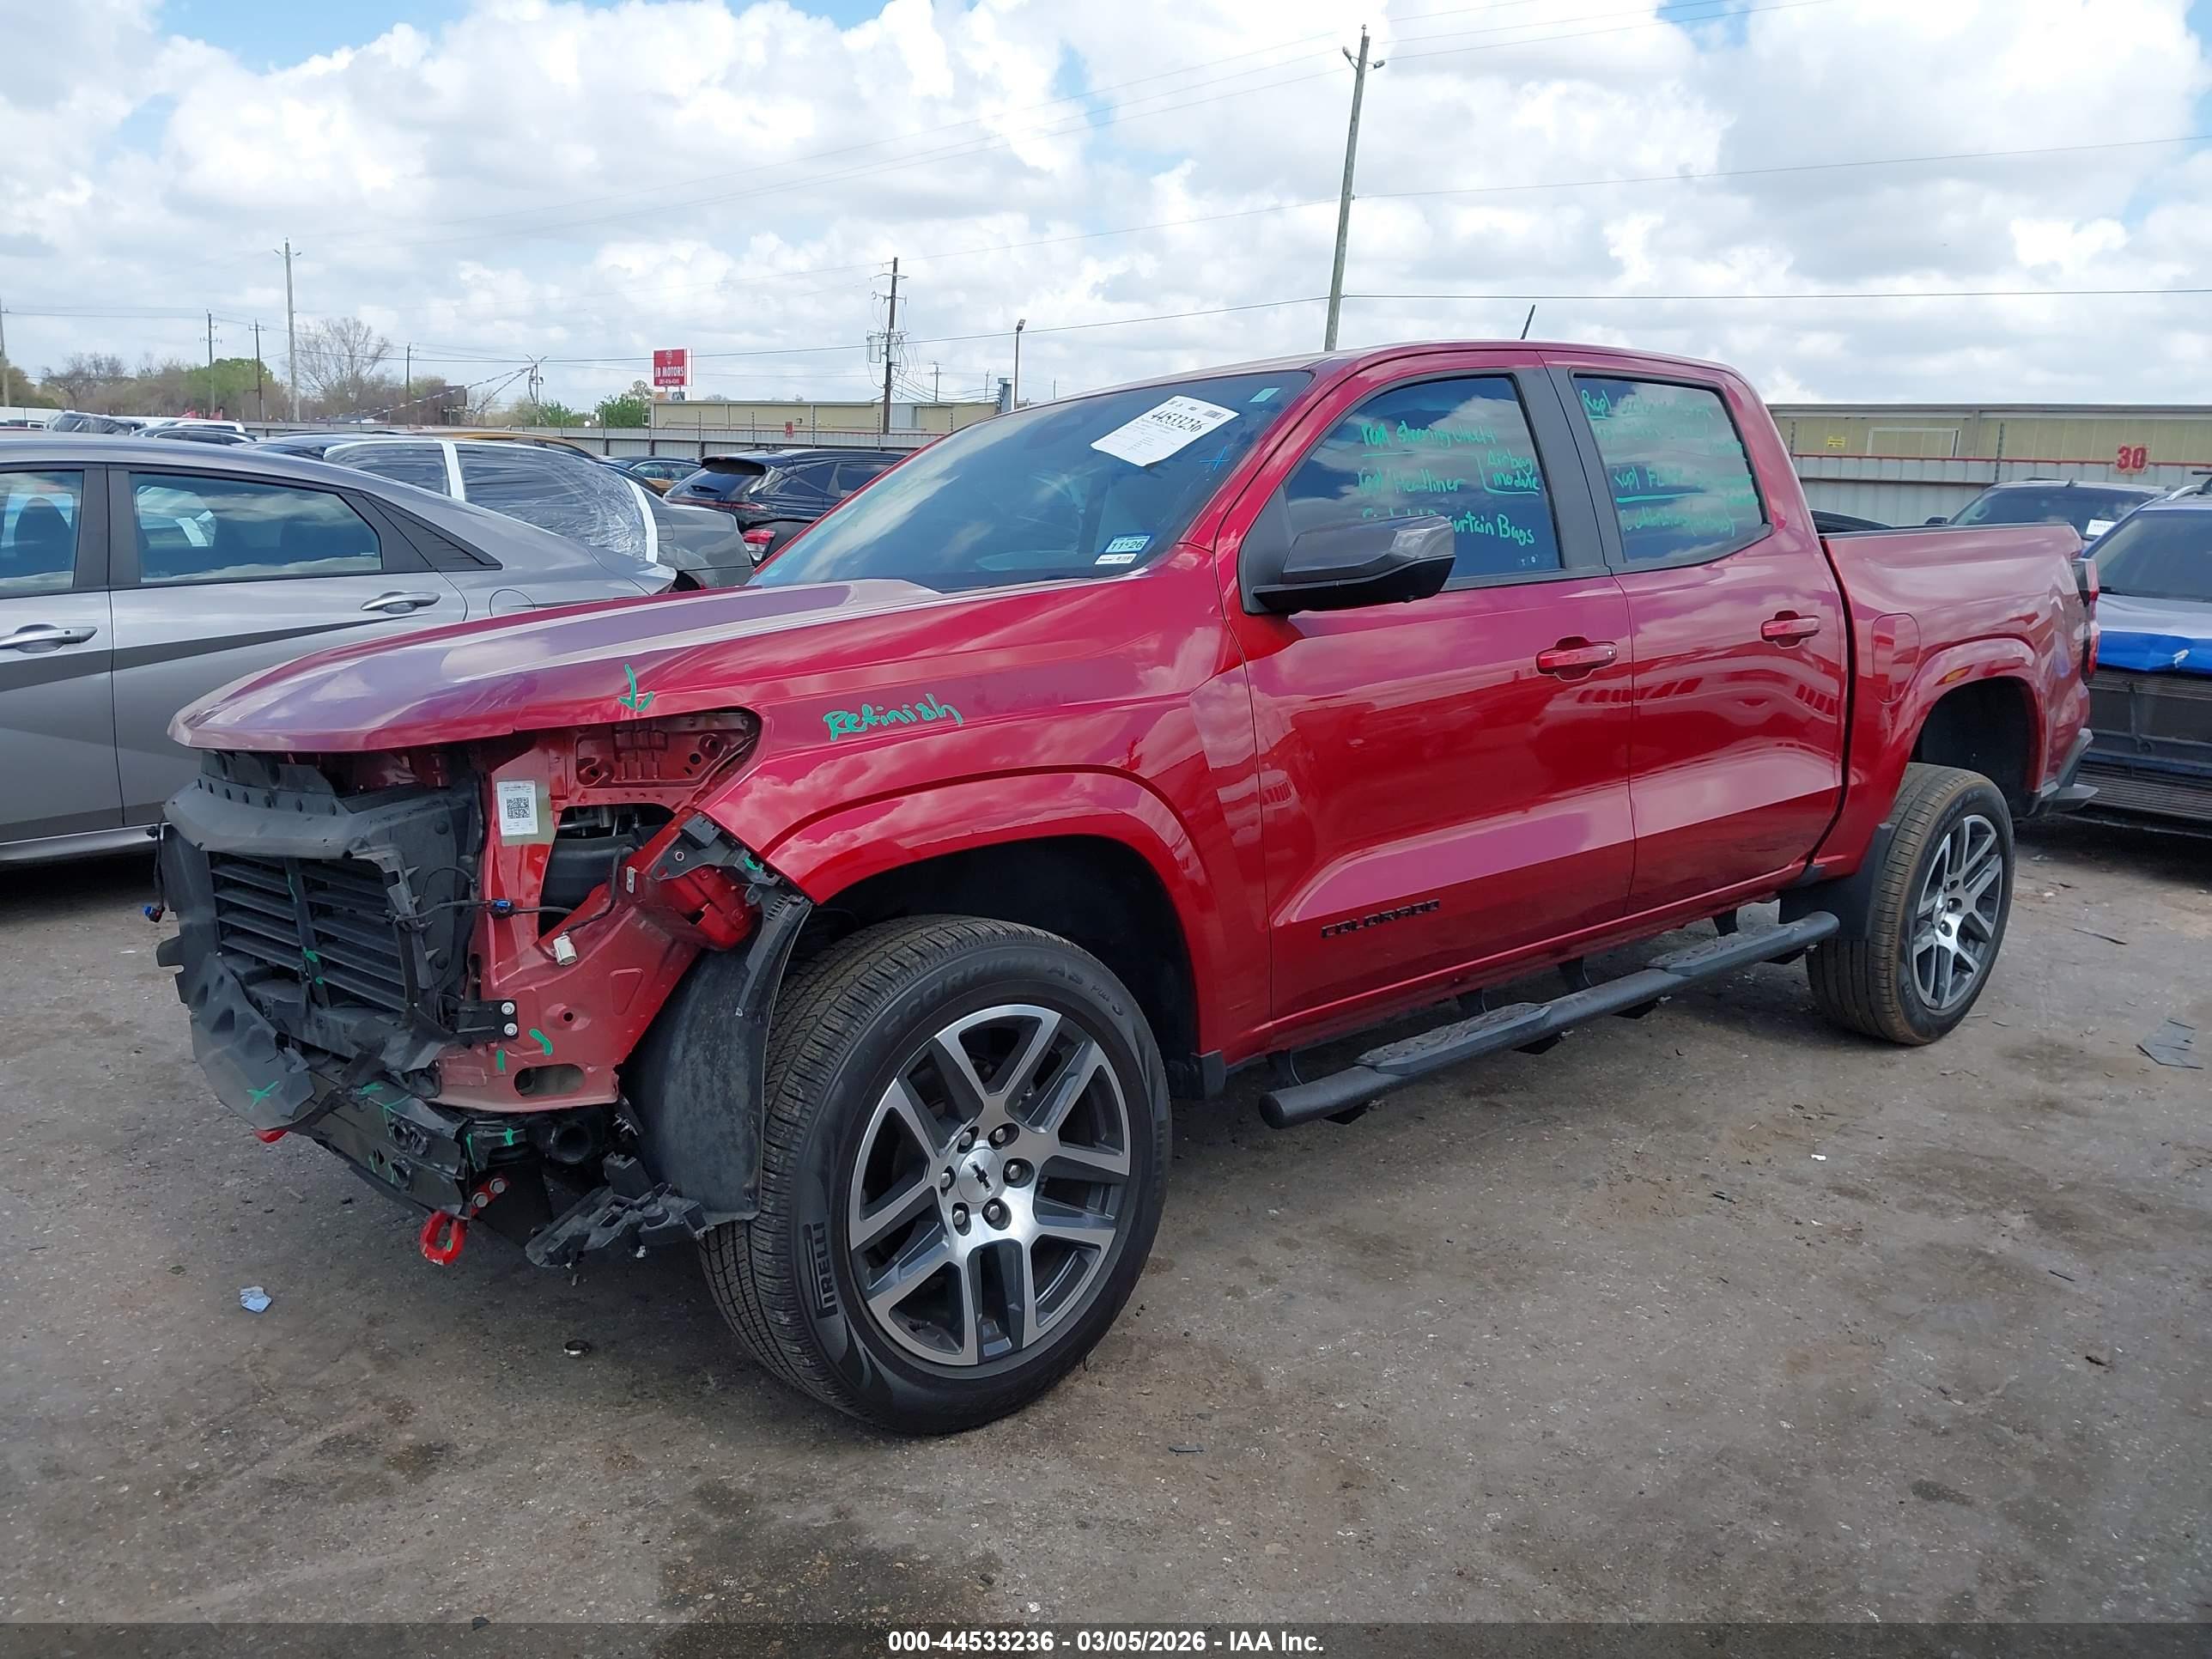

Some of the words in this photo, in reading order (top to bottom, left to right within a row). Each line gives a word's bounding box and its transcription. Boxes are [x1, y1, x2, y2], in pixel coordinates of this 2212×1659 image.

[662, 365, 684, 378] MOTORS
[1151, 410, 1208, 433] 44533236
[2118, 446, 2147, 469] 30
[1498, 514, 1535, 546] Bags
[1321, 899, 1440, 939] COLORADO
[802, 1221, 839, 1320] PIRELLI
